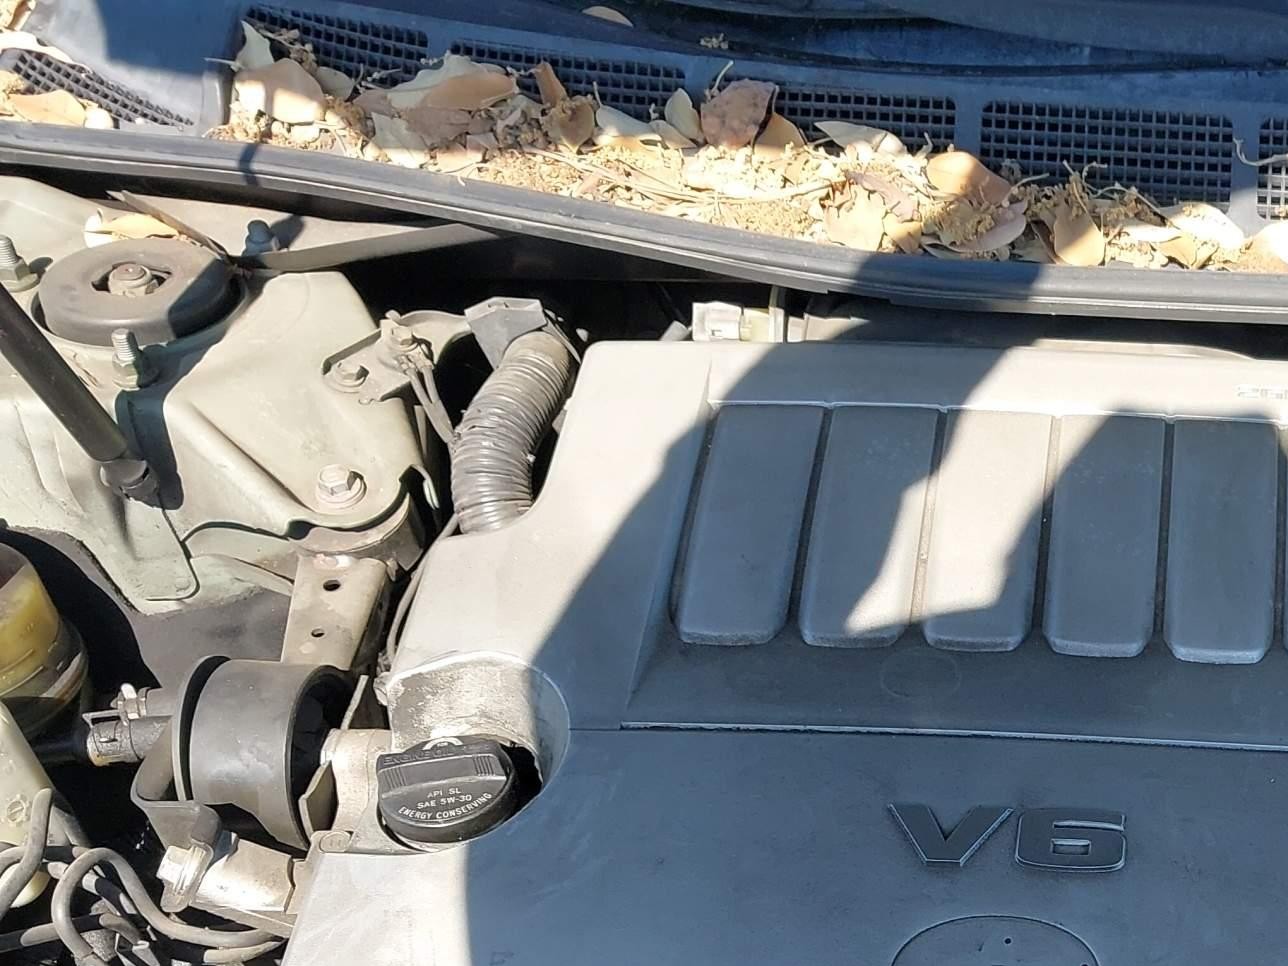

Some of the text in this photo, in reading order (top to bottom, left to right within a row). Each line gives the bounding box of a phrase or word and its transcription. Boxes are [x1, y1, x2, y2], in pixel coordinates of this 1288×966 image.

[416, 794, 473, 810] SAE 5W-30
[427, 787, 462, 799] API SL
[398, 792, 493, 820] ENERGY CONSERVING
[887, 803, 1128, 873] V6
